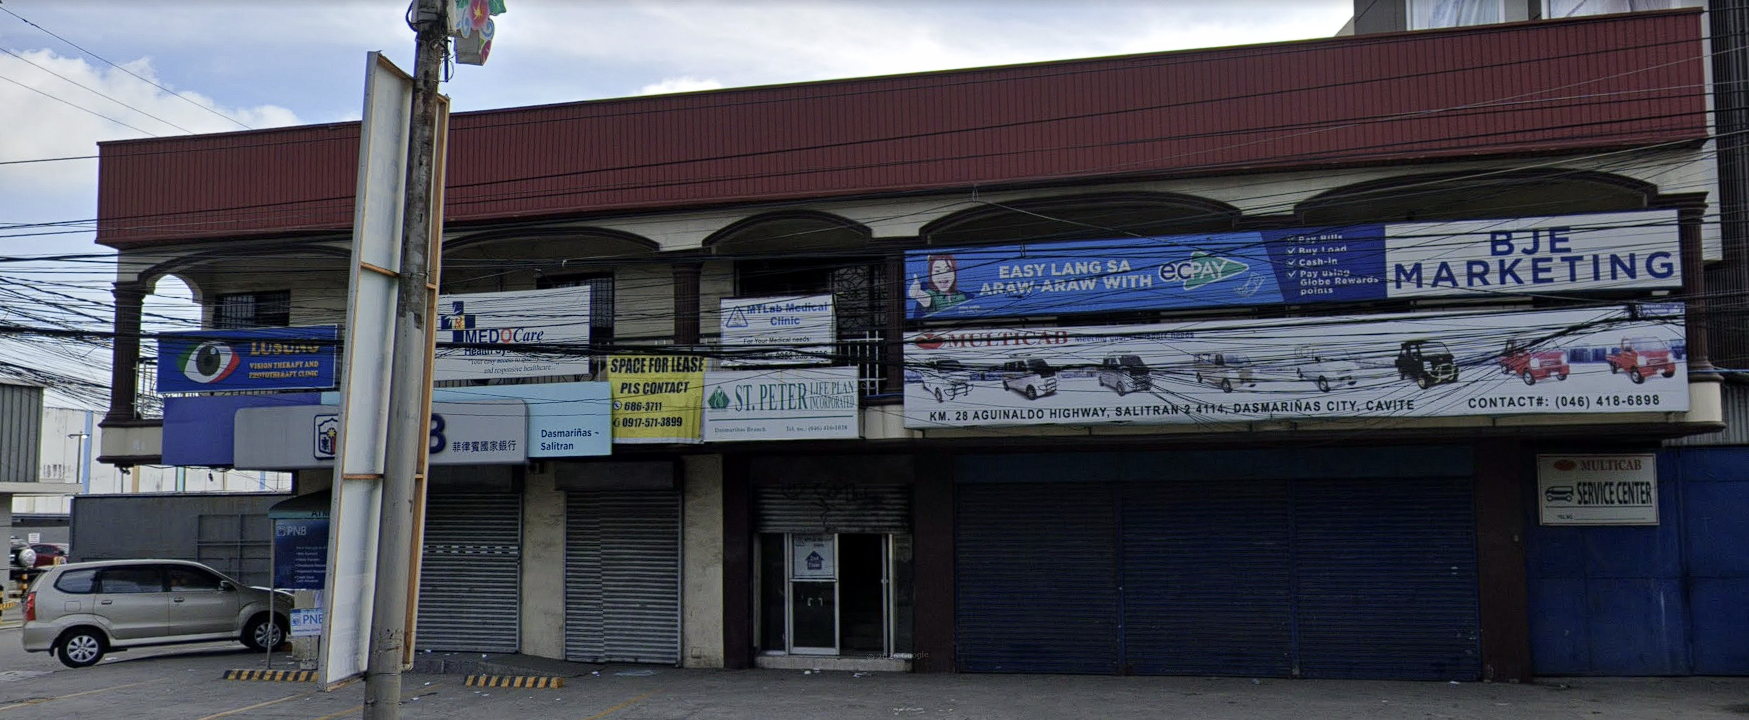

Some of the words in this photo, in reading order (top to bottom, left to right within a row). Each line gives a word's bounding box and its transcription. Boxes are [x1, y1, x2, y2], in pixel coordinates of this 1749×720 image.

[1490, 226, 1571, 257] BJE
[1299, 247, 1317, 255] Buy
[1321, 245, 1347, 253] Load
[1299, 257, 1338, 266] Cash-in
[999, 264, 1046, 279] EASY
[1051, 261, 1102, 277] LANG
[1106, 260, 1132, 274] SA
[1300, 270, 1318, 279] Pay
[1322, 269, 1350, 278] using
[1394, 252, 1675, 290] MARKETING
[979, 277, 1098, 297] ARAW-ARAW
[1101, 274, 1152, 290] WITH
[1300, 278, 1331, 286] Globe
[1334, 276, 1379, 285] Rewards
[1300, 286, 1333, 296] points
[746, 304, 782, 315] MTLab
[786, 302, 828, 313] Medical
[770, 316, 800, 326] Clinic
[947, 330, 1068, 348] MULTICAB
[249, 361, 273, 370] VISION
[273, 361, 304, 369] THERAPY
[304, 360, 319, 368] AND
[610, 357, 648, 374] SPACE
[650, 357, 670, 373] FOR
[671, 356, 704, 373] LEASE
[620, 382, 641, 394] PLS
[643, 381, 690, 394] CONTACT
[810, 381, 830, 395] LIFE
[831, 381, 855, 395] PLAN
[735, 382, 755, 412] ST.
[759, 382, 808, 411] PETER
[810, 394, 855, 410] INCORPORATED
[1468, 396, 1550, 409] CONTACT#:
[1554, 395, 1590, 410] (046)
[1596, 394, 1660, 407] 418-6898
[624, 401, 662, 411] 686-3711
[929, 410, 950, 422] KM.
[955, 410, 968, 421] 28
[972, 408, 1045, 421] AGUINALDO
[1049, 406, 1111, 420] HIGHWAY,
[1115, 404, 1179, 417] SALITRAN
[1184, 404, 1191, 415] 2
[1196, 403, 1228, 416] 4114,
[1233, 398, 1321, 414] DASMARIÑAS
[1326, 400, 1361, 413] CITY,
[1366, 399, 1414, 411] CAVITE
[622, 417, 683, 427] 0917-571-3899
[540, 428, 592, 438] Dasmariñas
[540, 441, 574, 451] Salitran
[1580, 459, 1642, 471] MULTICAB
[1577, 481, 1614, 505] SERVICE
[1616, 481, 1653, 505] CENTER
[287, 526, 307, 536] PNB
